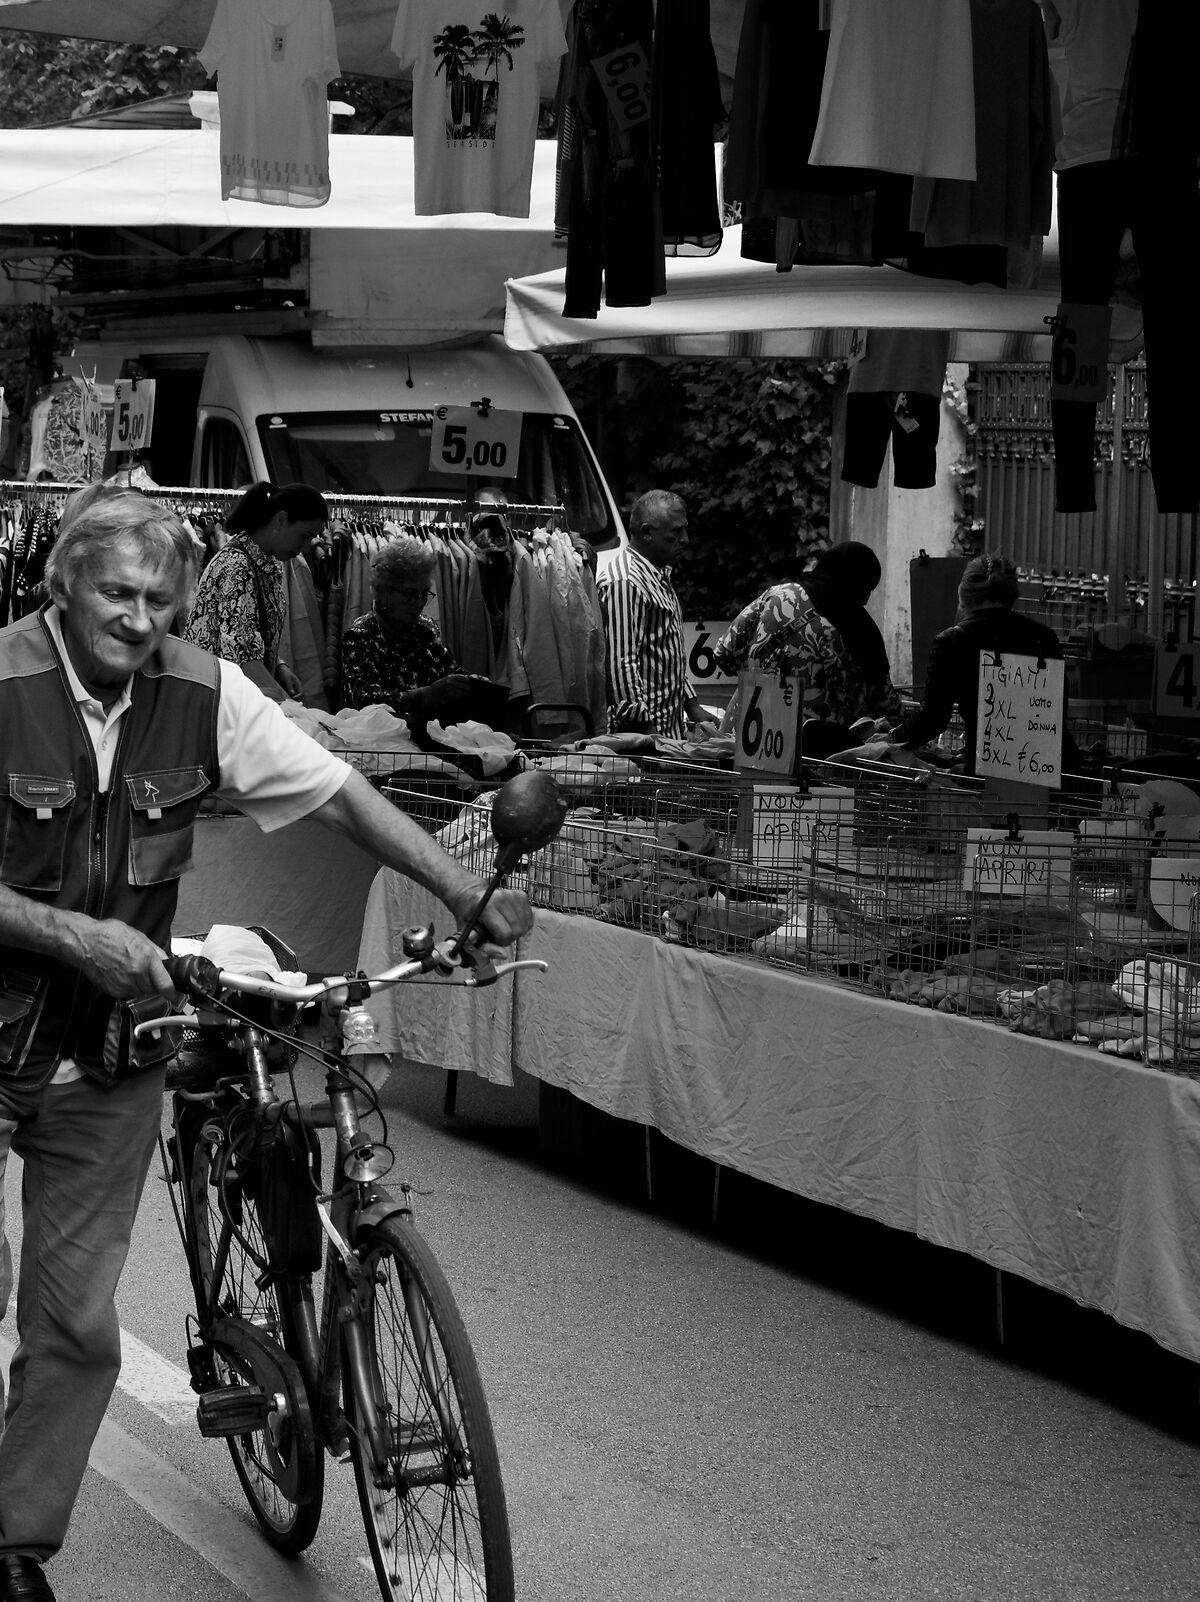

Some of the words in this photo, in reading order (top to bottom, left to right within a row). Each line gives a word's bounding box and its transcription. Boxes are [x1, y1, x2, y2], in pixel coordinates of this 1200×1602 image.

[605, 53, 647, 120] 6,00
[1053, 329, 1098, 390] 6,00
[116, 385, 122, 400] €
[118, 402, 144, 446] 5,00
[436, 406, 448, 421] €
[442, 425, 507, 471] 5,00
[783, 684, 794, 707] €
[1029, 697, 1052, 708] UOMO
[742, 686, 784, 761] 6,00
[984, 717, 1014, 742] 4XL
[981, 742, 1012, 766] 5XL
[760, 795, 805, 809] NON
[978, 835, 1024, 854] NON
